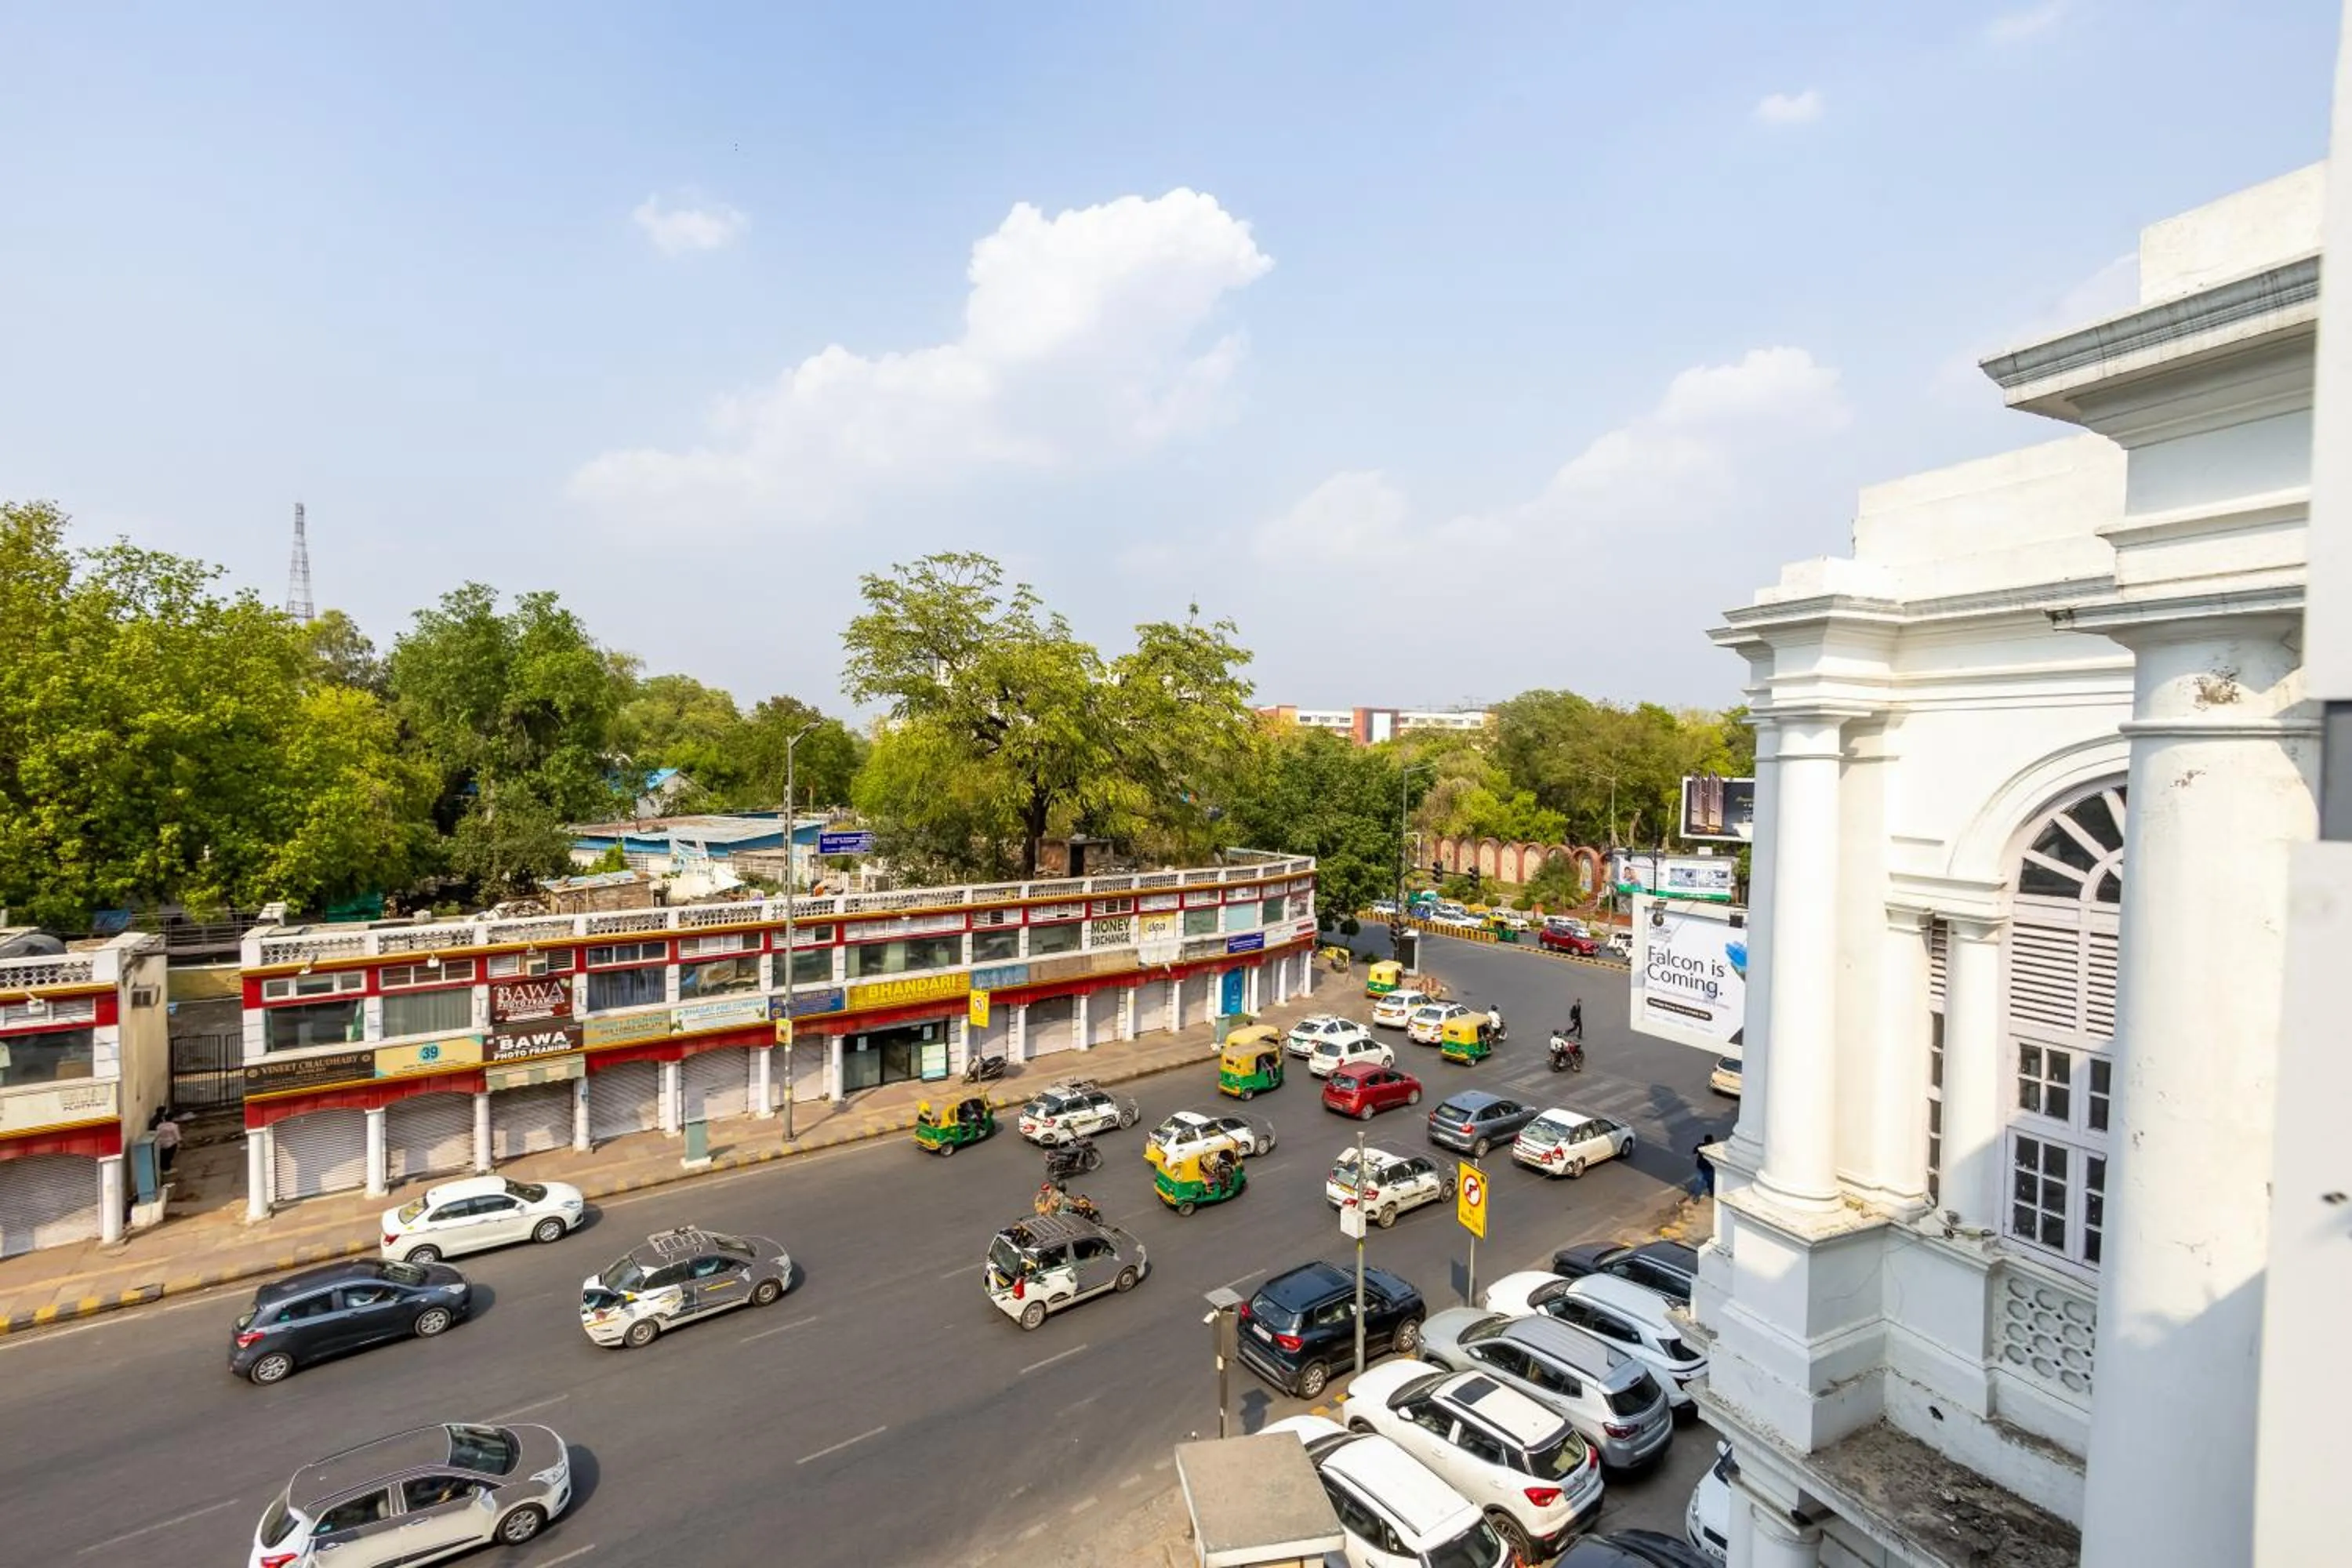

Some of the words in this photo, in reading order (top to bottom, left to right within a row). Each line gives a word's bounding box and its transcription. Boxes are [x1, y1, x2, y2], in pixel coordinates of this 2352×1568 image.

[1091, 917, 1130, 935] MONEY
[1091, 933, 1130, 946] EXCHANGE
[1647, 945, 1704, 973] Falcon
[1711, 959, 1725, 978] is
[868, 975, 956, 998] BHANDARI
[1647, 963, 1723, 999] Coming.
[497, 981, 564, 1001] BAWA
[499, 1031, 567, 1050] BAWA
[422, 1045, 439, 1060] 39
[493, 1050, 528, 1062] PHOTO
